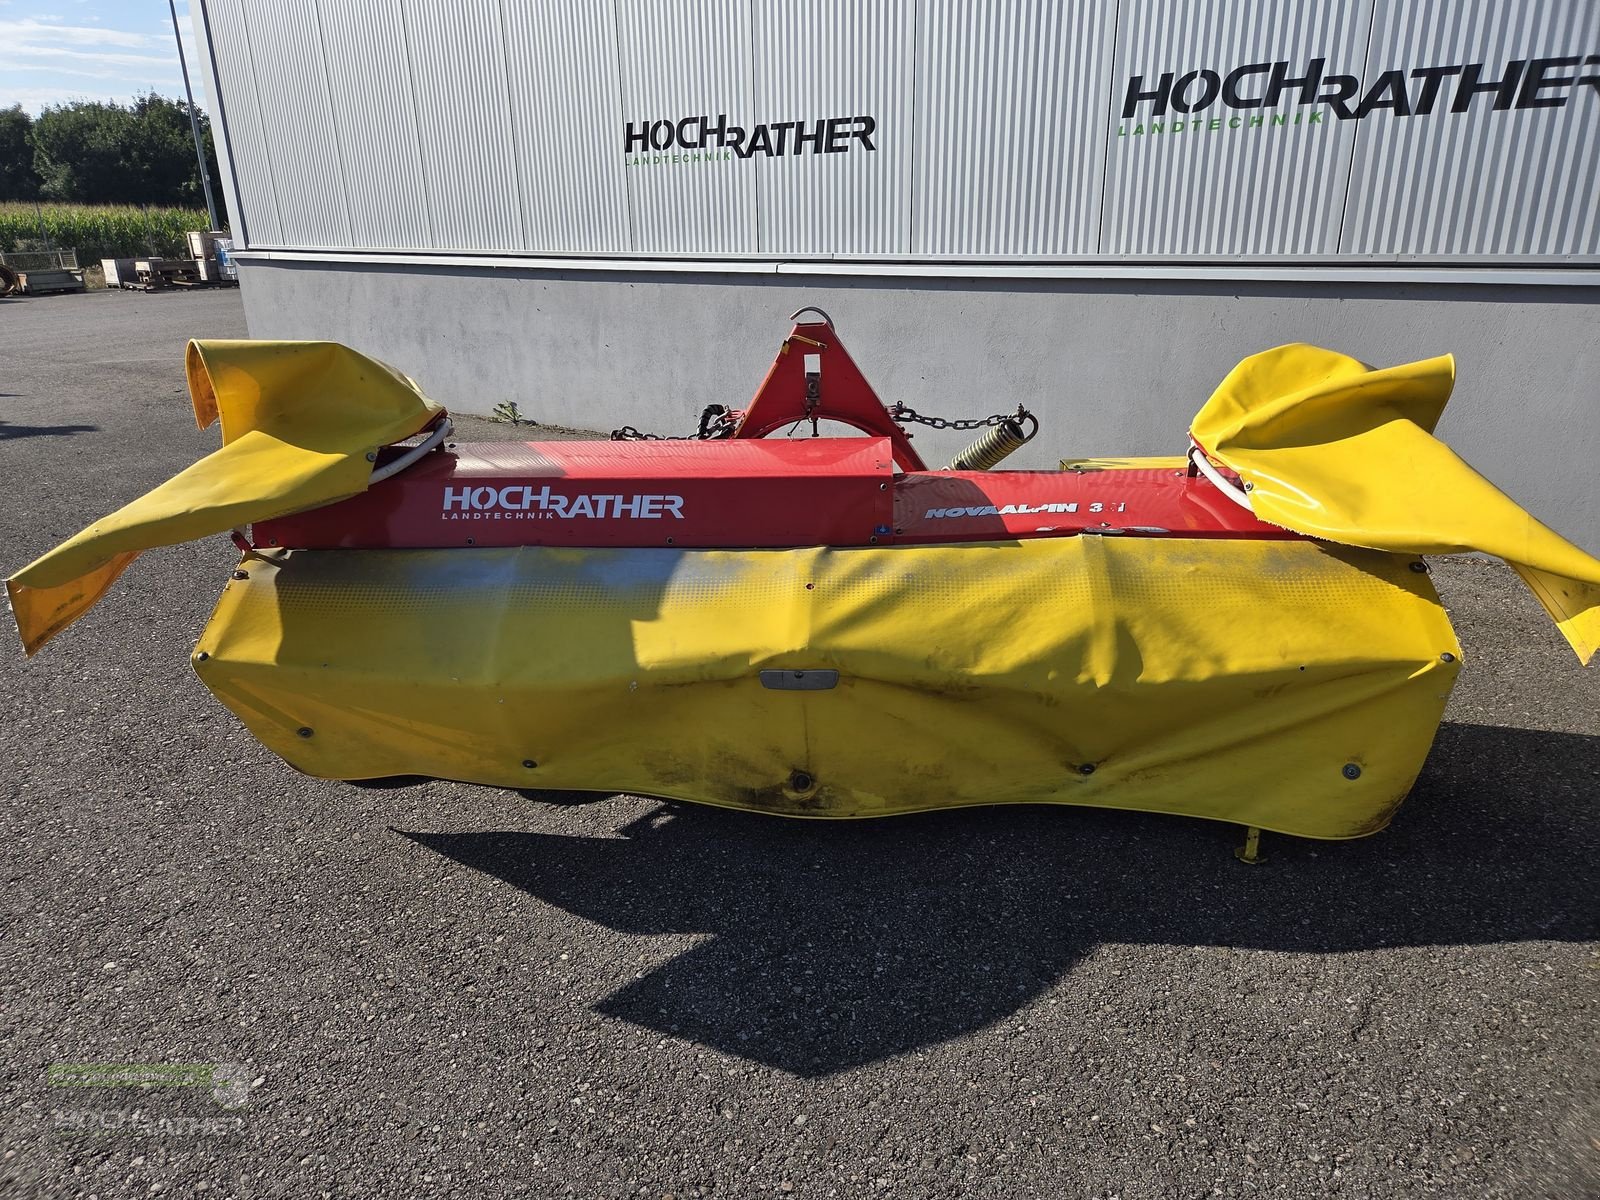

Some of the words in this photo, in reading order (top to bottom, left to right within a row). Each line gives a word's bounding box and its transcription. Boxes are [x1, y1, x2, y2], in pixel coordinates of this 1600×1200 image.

[625, 114, 876, 159] HOCHRATHER
[1118, 111, 1324, 137] LANDTECHNIK
[441, 512, 554, 520] LANDTECHNIK
[443, 486, 685, 519] HOCHRATHER
